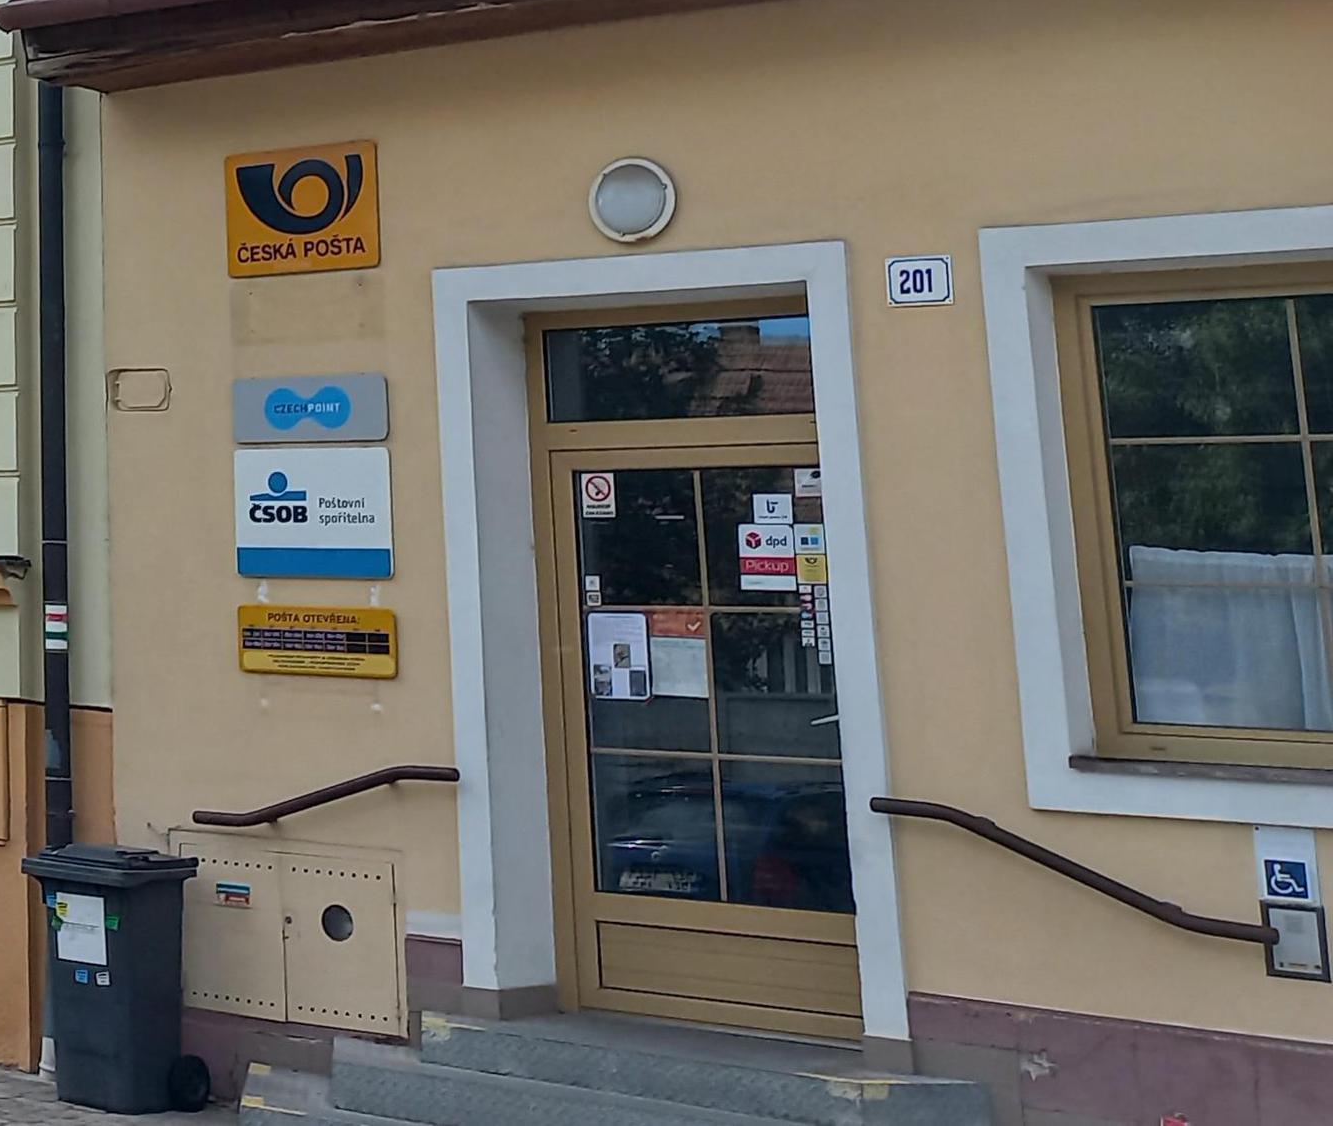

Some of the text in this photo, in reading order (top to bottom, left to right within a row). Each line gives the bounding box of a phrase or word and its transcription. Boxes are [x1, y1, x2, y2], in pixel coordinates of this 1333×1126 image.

[237, 234, 366, 264] ČESKÁ POŠTA
[899, 268, 933, 295] 201
[318, 497, 366, 509] Poštovní
[249, 502, 309, 524] ČSOB
[318, 511, 376, 526] spořitelna
[765, 535, 788, 549] dpd
[745, 560, 790, 574] Pickup
[267, 611, 301, 623] POŠTA
